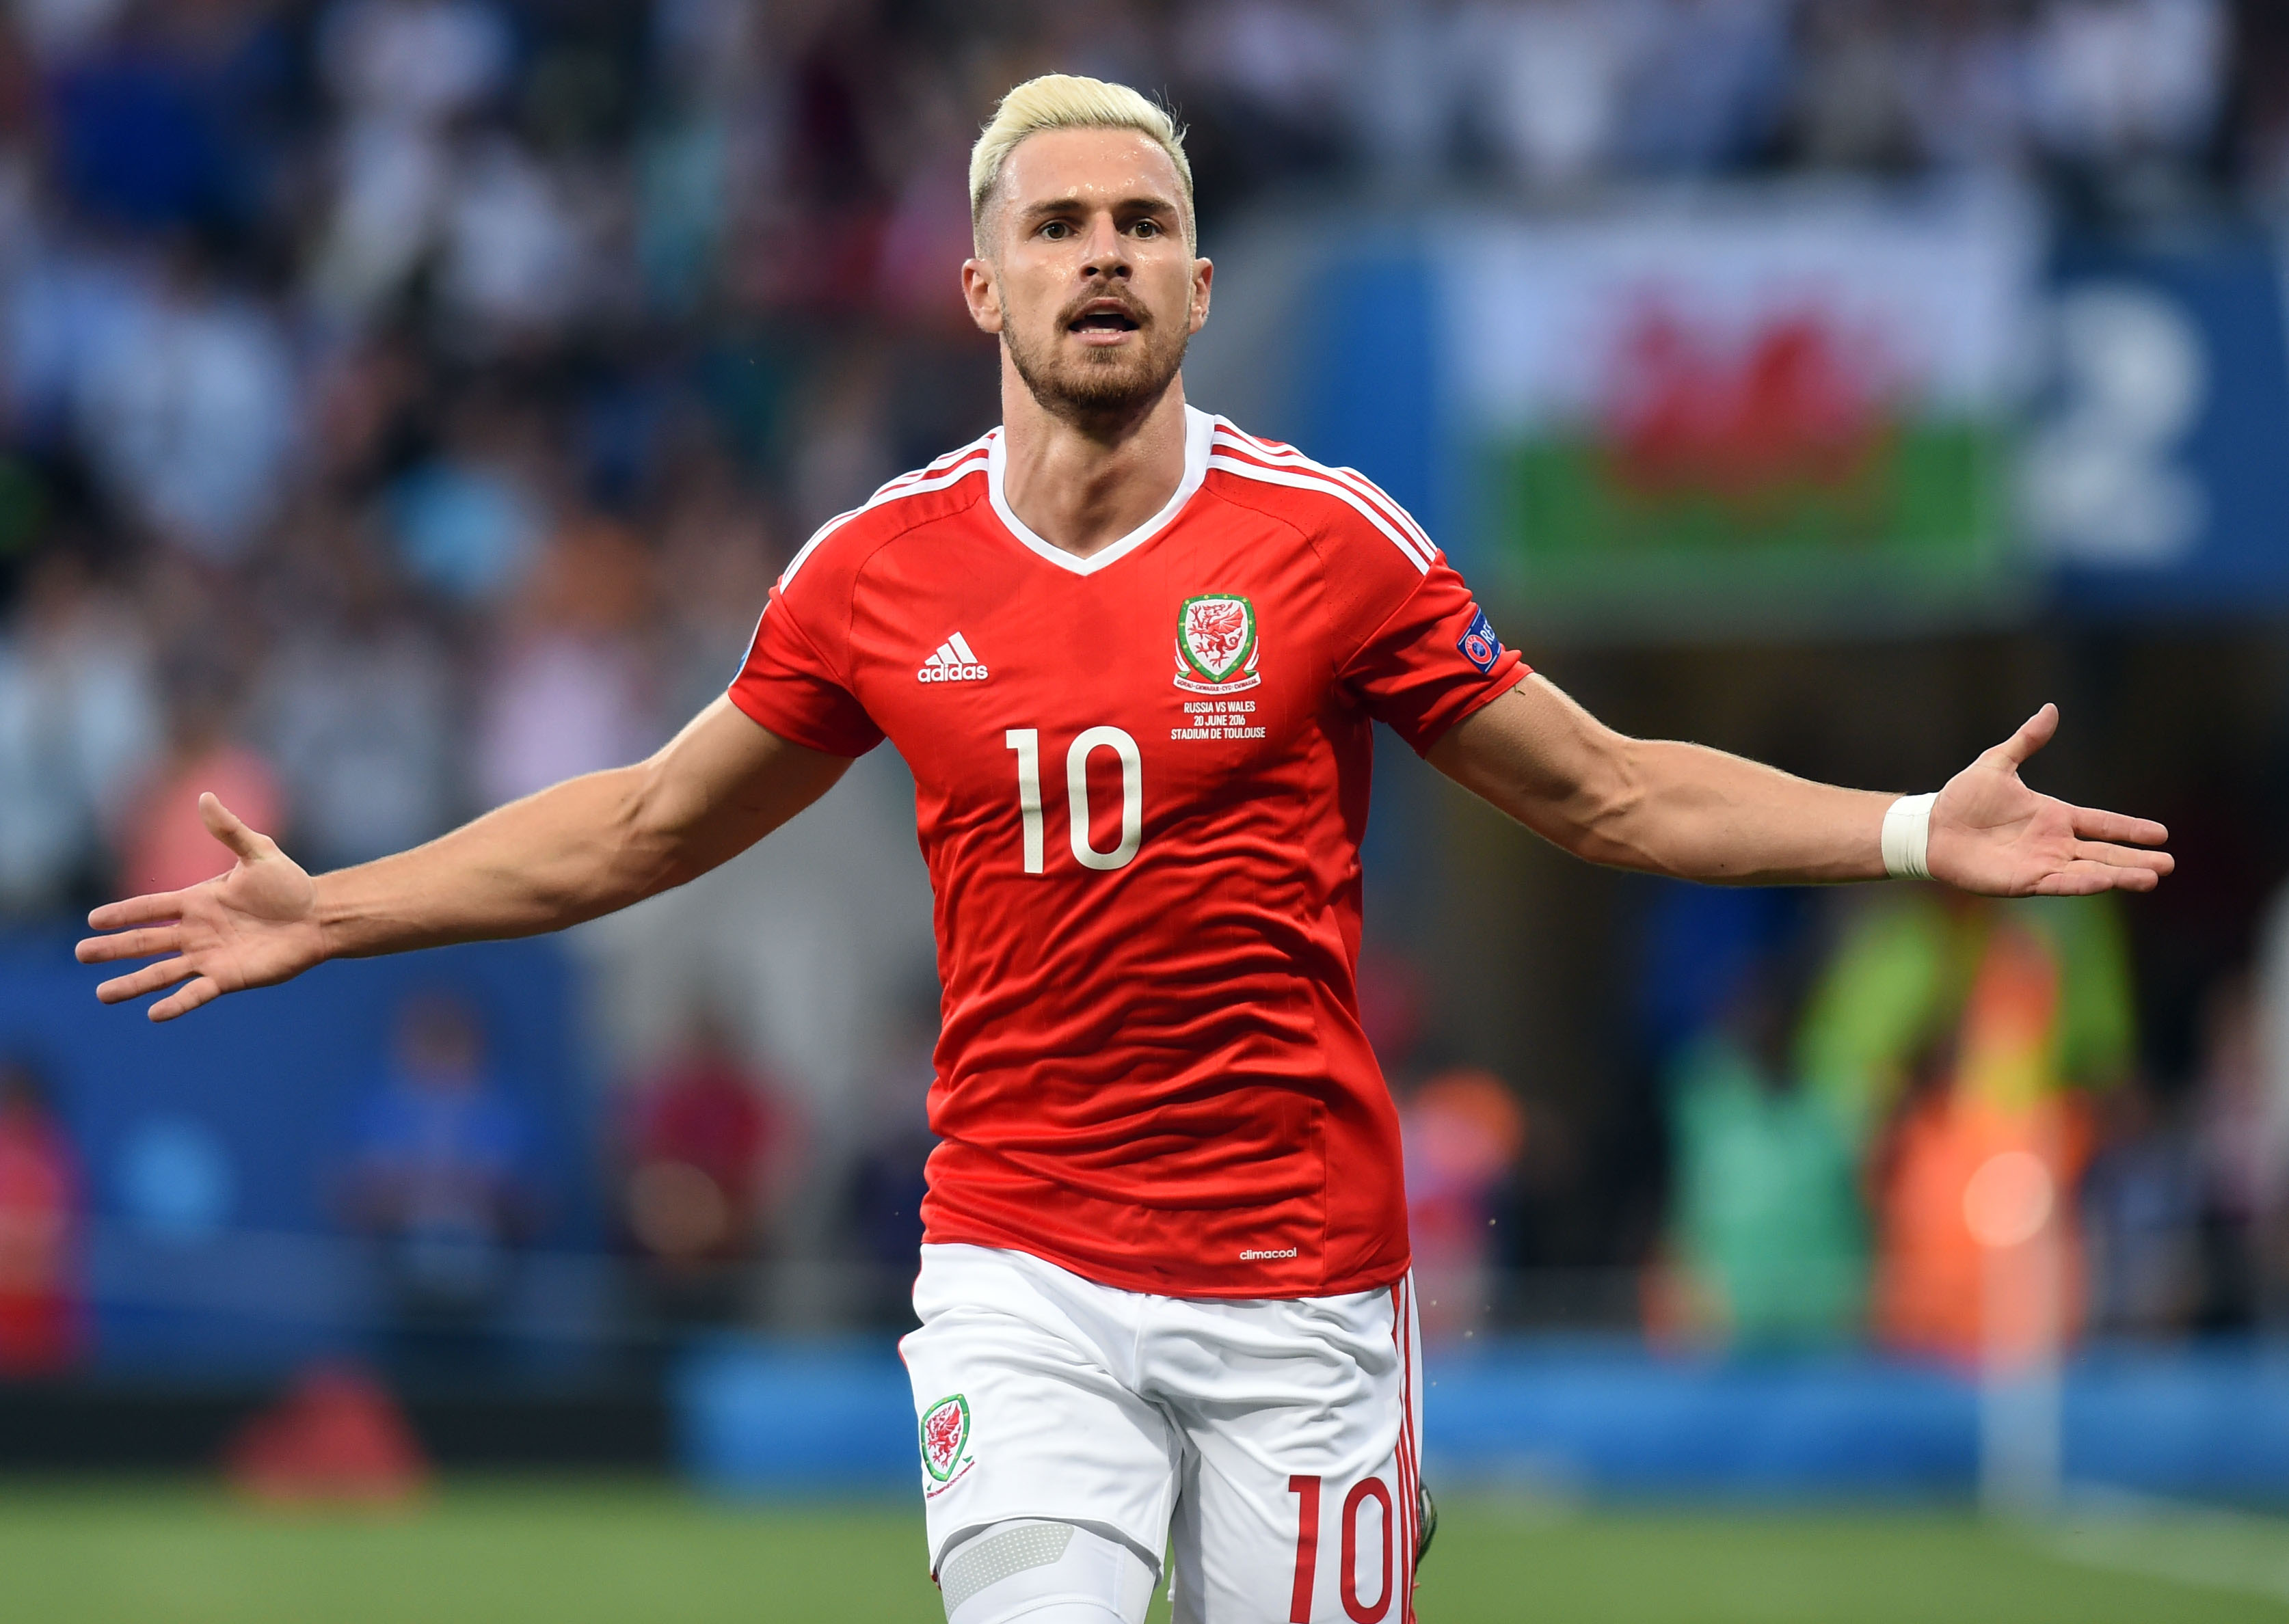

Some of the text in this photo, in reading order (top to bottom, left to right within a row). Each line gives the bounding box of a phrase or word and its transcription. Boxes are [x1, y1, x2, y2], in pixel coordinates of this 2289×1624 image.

[917, 662, 989, 683] adidas
[1183, 701, 1256, 713] RUSSIA VS WALES
[1194, 714, 1246, 726] 20 JUNE 2016
[1171, 727, 1266, 740] STADIUM DE TOULOUSE
[1006, 726, 1142, 874] 10
[1240, 1247, 1297, 1260] climacool
[1288, 1474, 1393, 1624] 10
